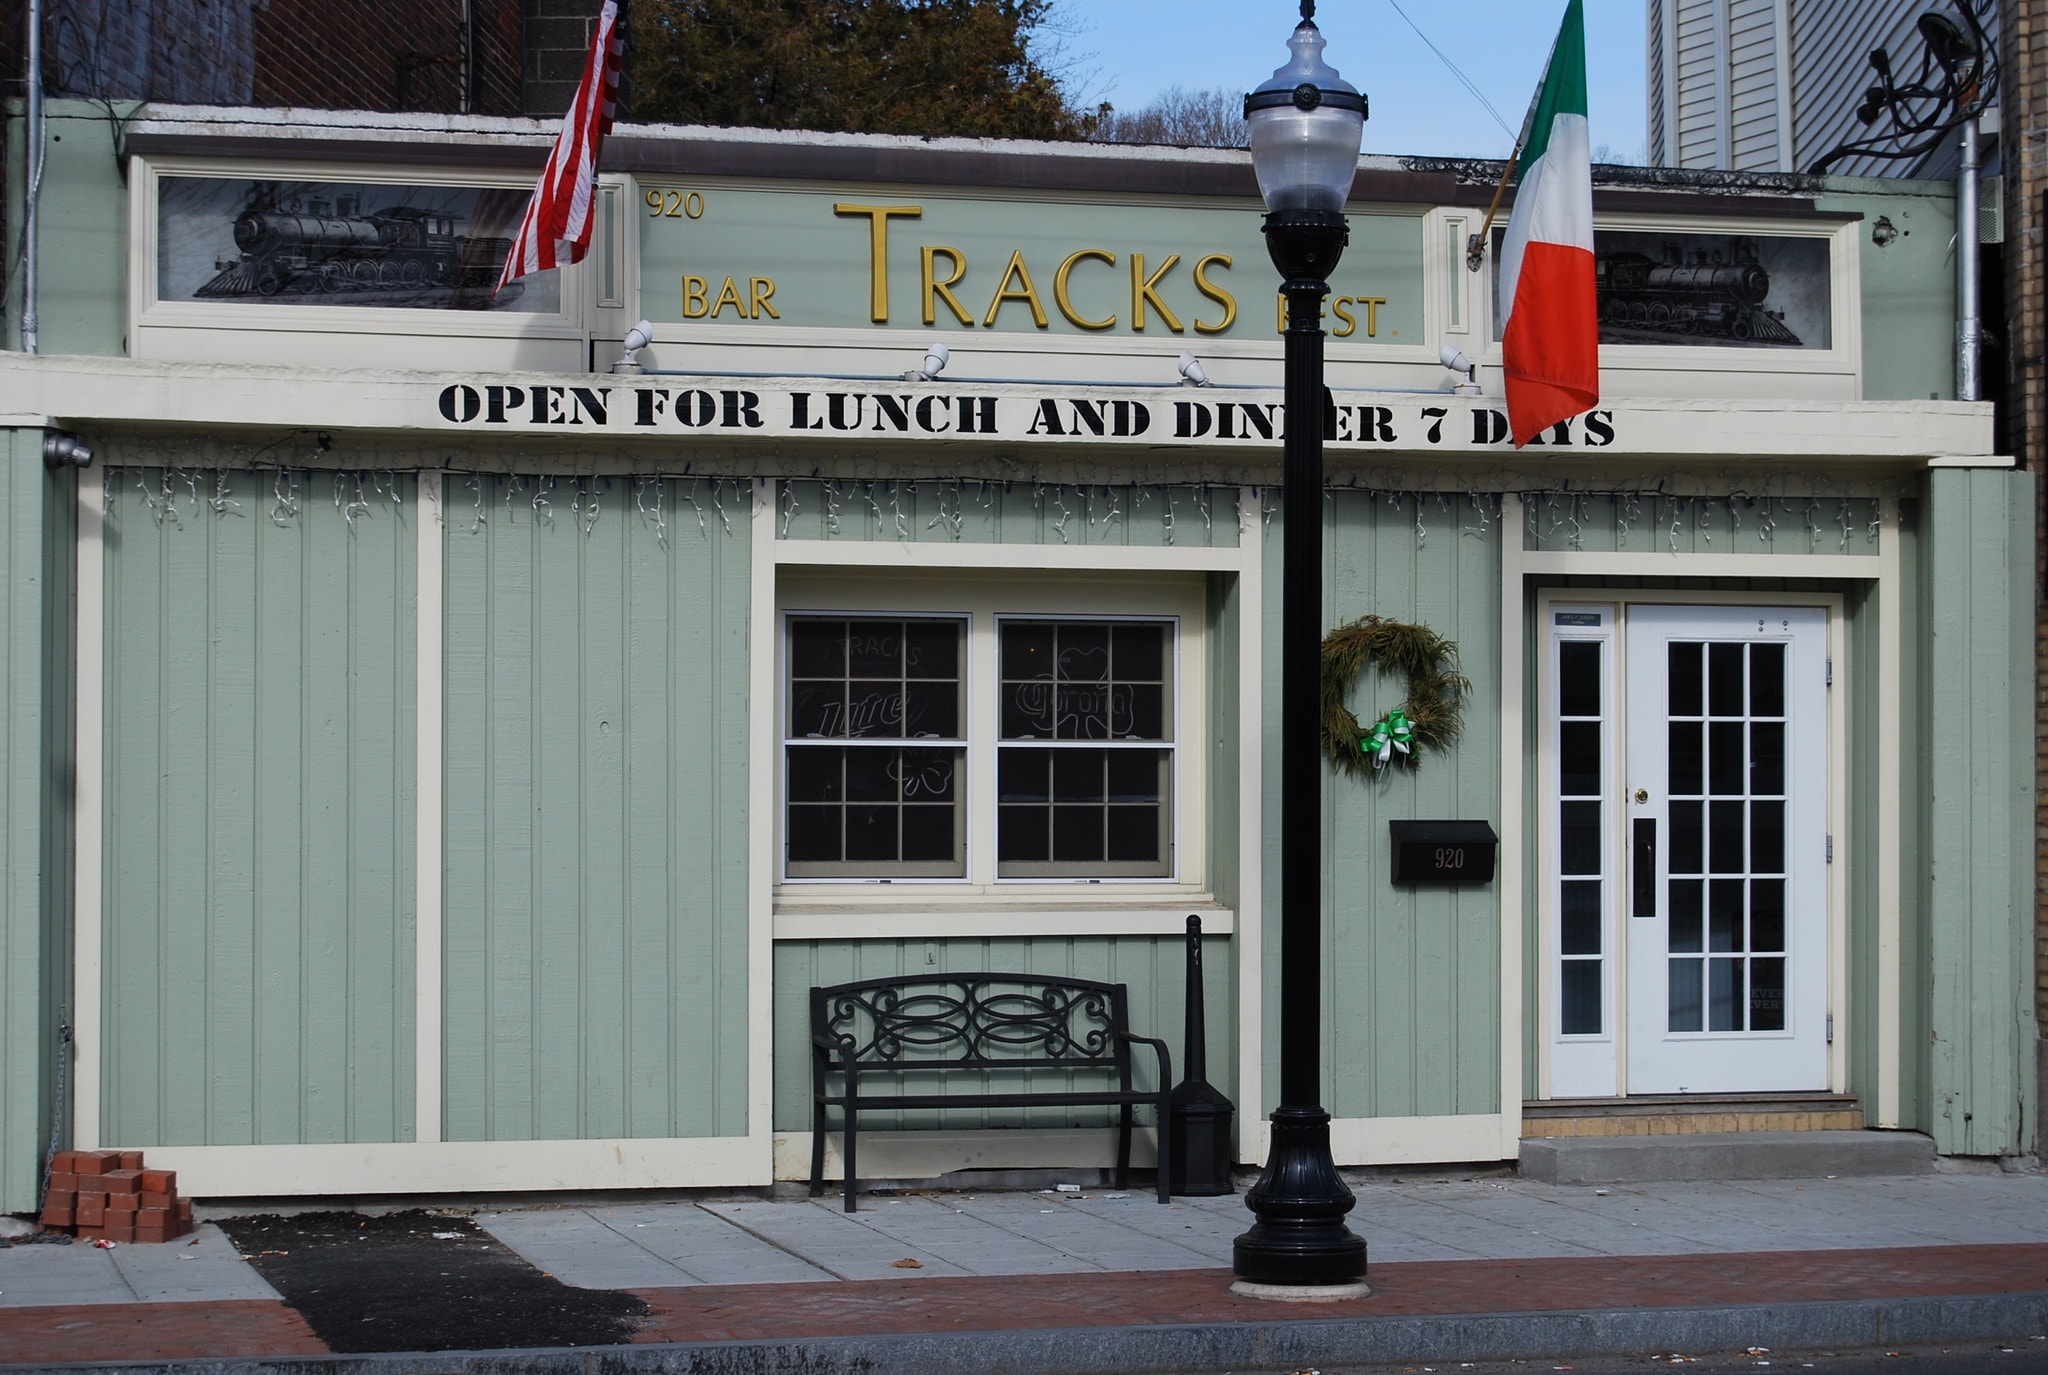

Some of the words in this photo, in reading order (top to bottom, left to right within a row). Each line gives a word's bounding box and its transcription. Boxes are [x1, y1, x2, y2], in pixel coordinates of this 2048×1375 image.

[646, 190, 704, 219] 920
[682, 275, 781, 319] BAR
[833, 203, 1237, 333] TRACKS
[1277, 293, 1387, 338] ST
[438, 384, 612, 425] OPEN
[634, 388, 765, 428] FOR
[789, 391, 999, 434] LUNCH
[1026, 397, 1151, 438] AND
[1173, 401, 1398, 443] DINER
[1420, 407, 1449, 444] 7
[1015, 682, 1126, 719] Corona
[1434, 847, 1464, 869] 920
